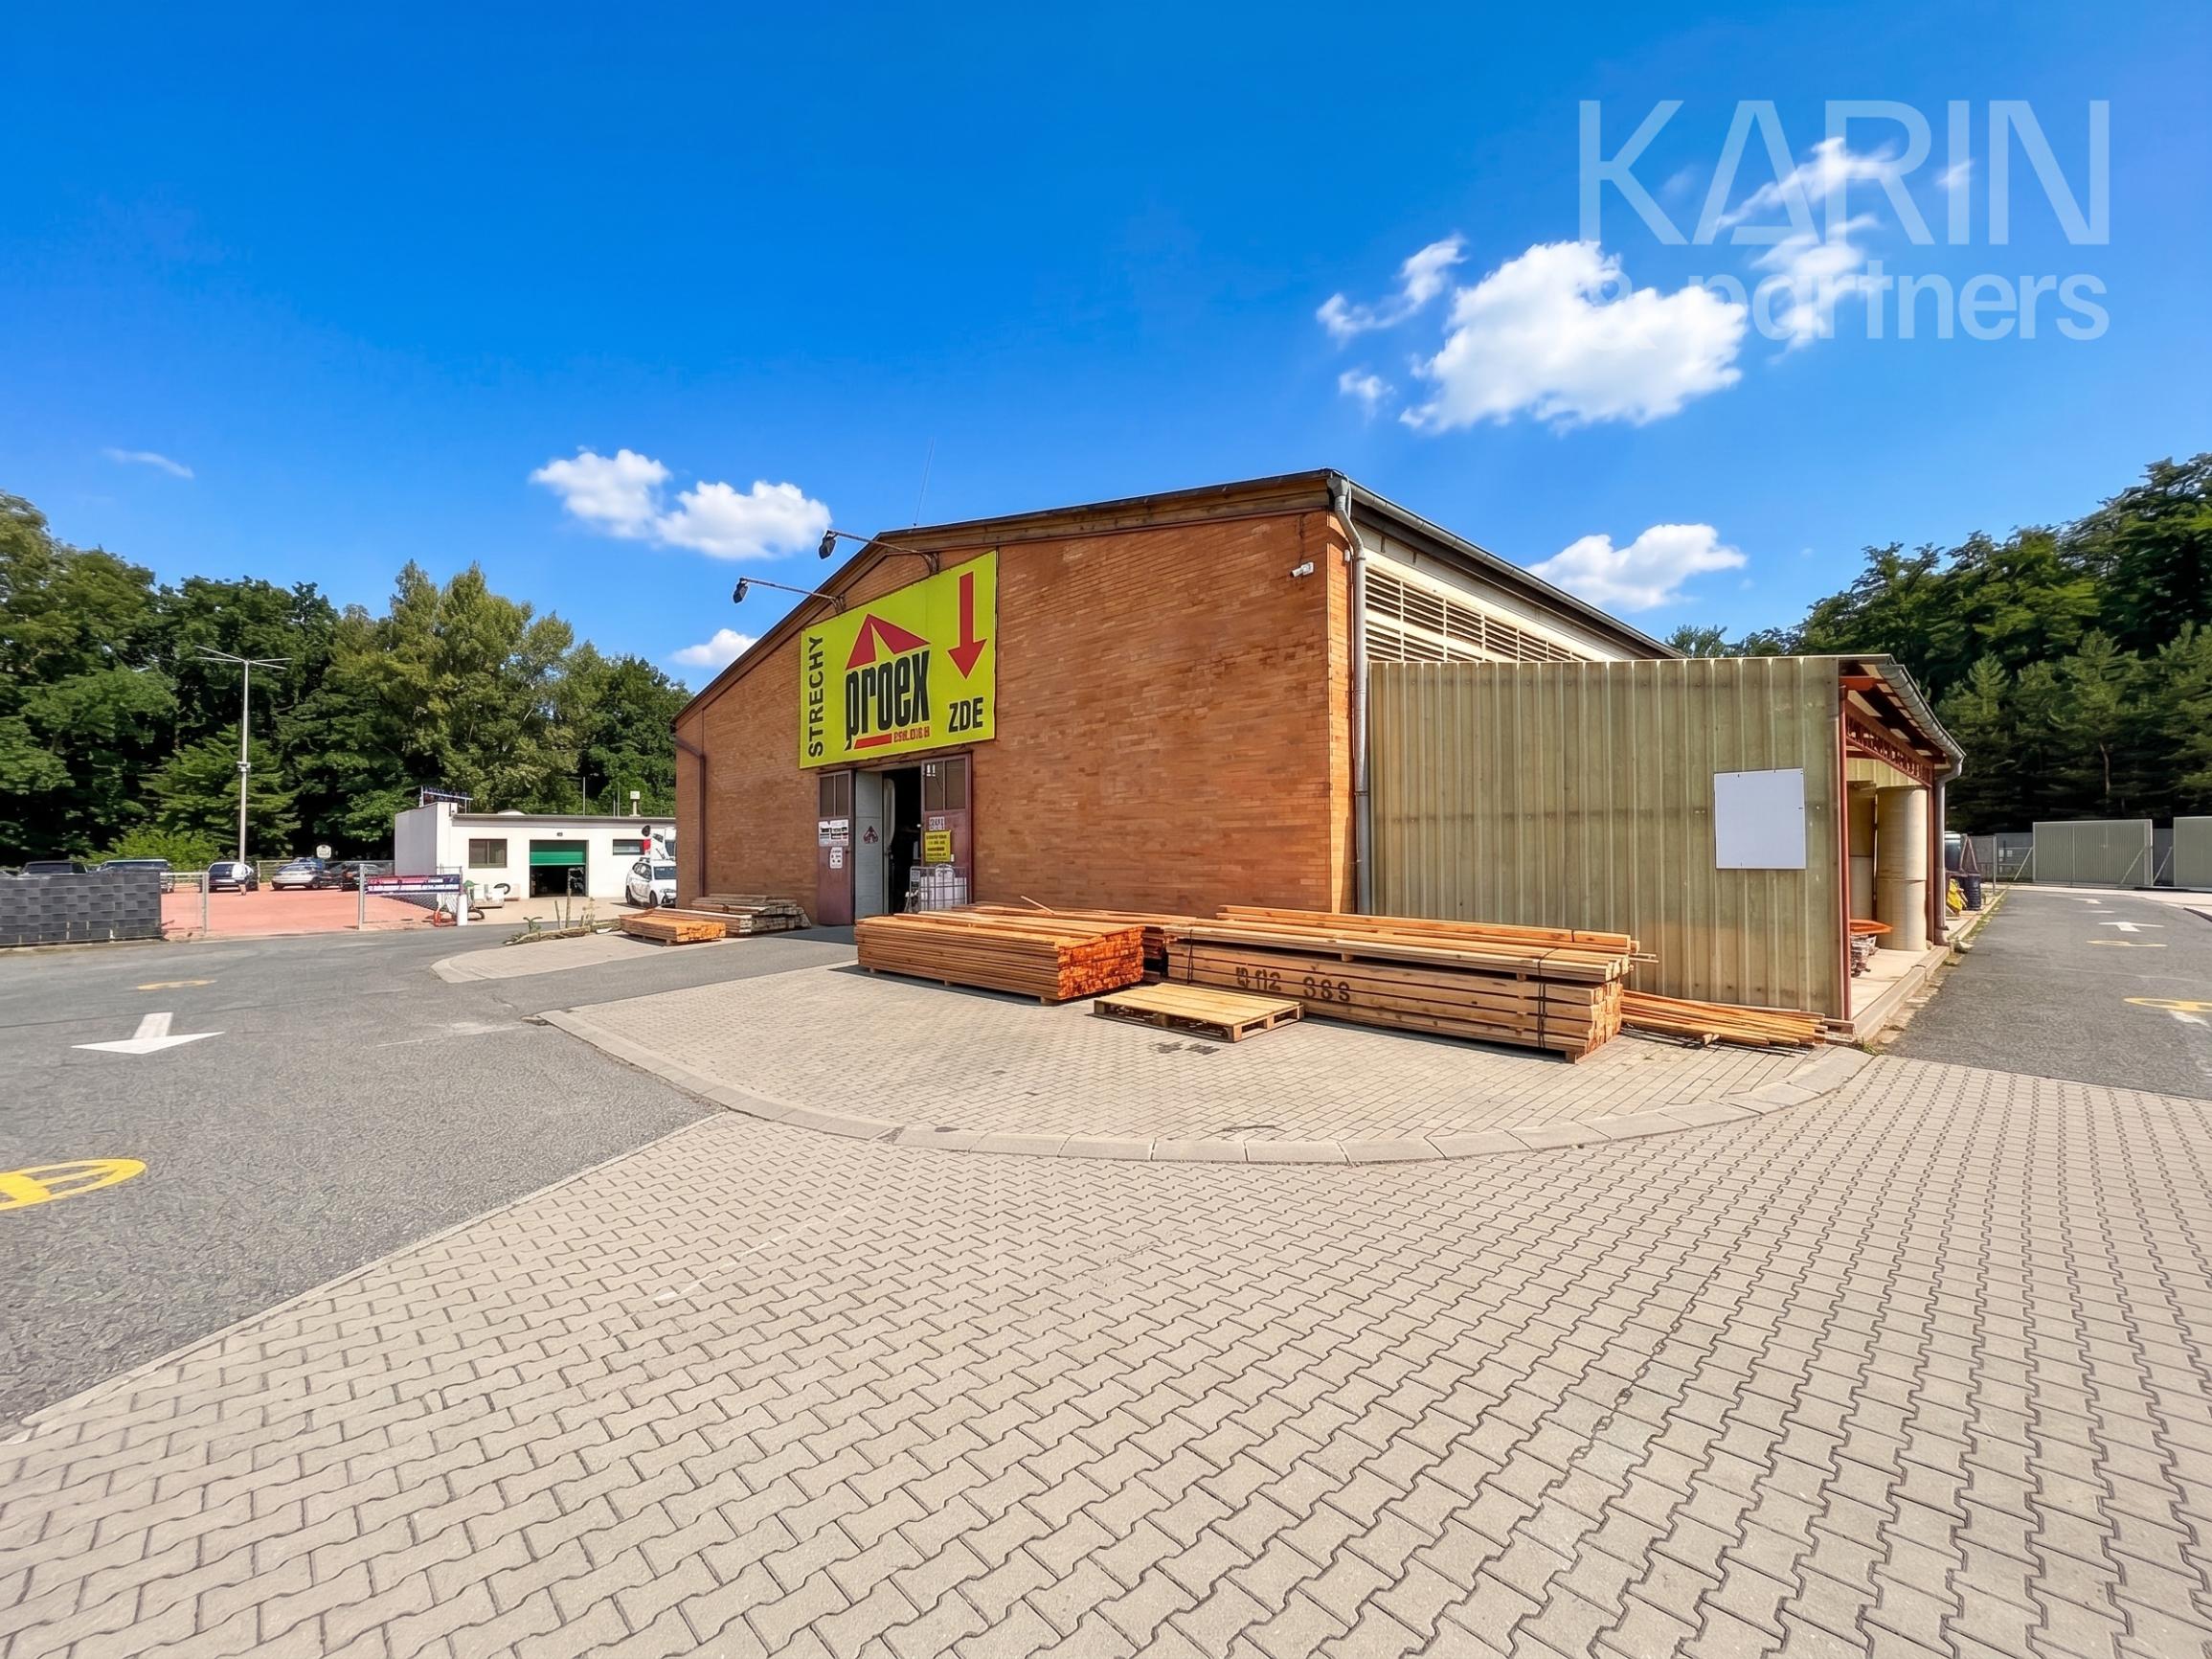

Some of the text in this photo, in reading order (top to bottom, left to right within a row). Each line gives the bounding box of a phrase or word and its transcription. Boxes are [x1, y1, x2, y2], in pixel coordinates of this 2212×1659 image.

[808, 636, 824, 758] STRECHY
[844, 649, 930, 751] proex
[948, 696, 984, 733] ZDE
